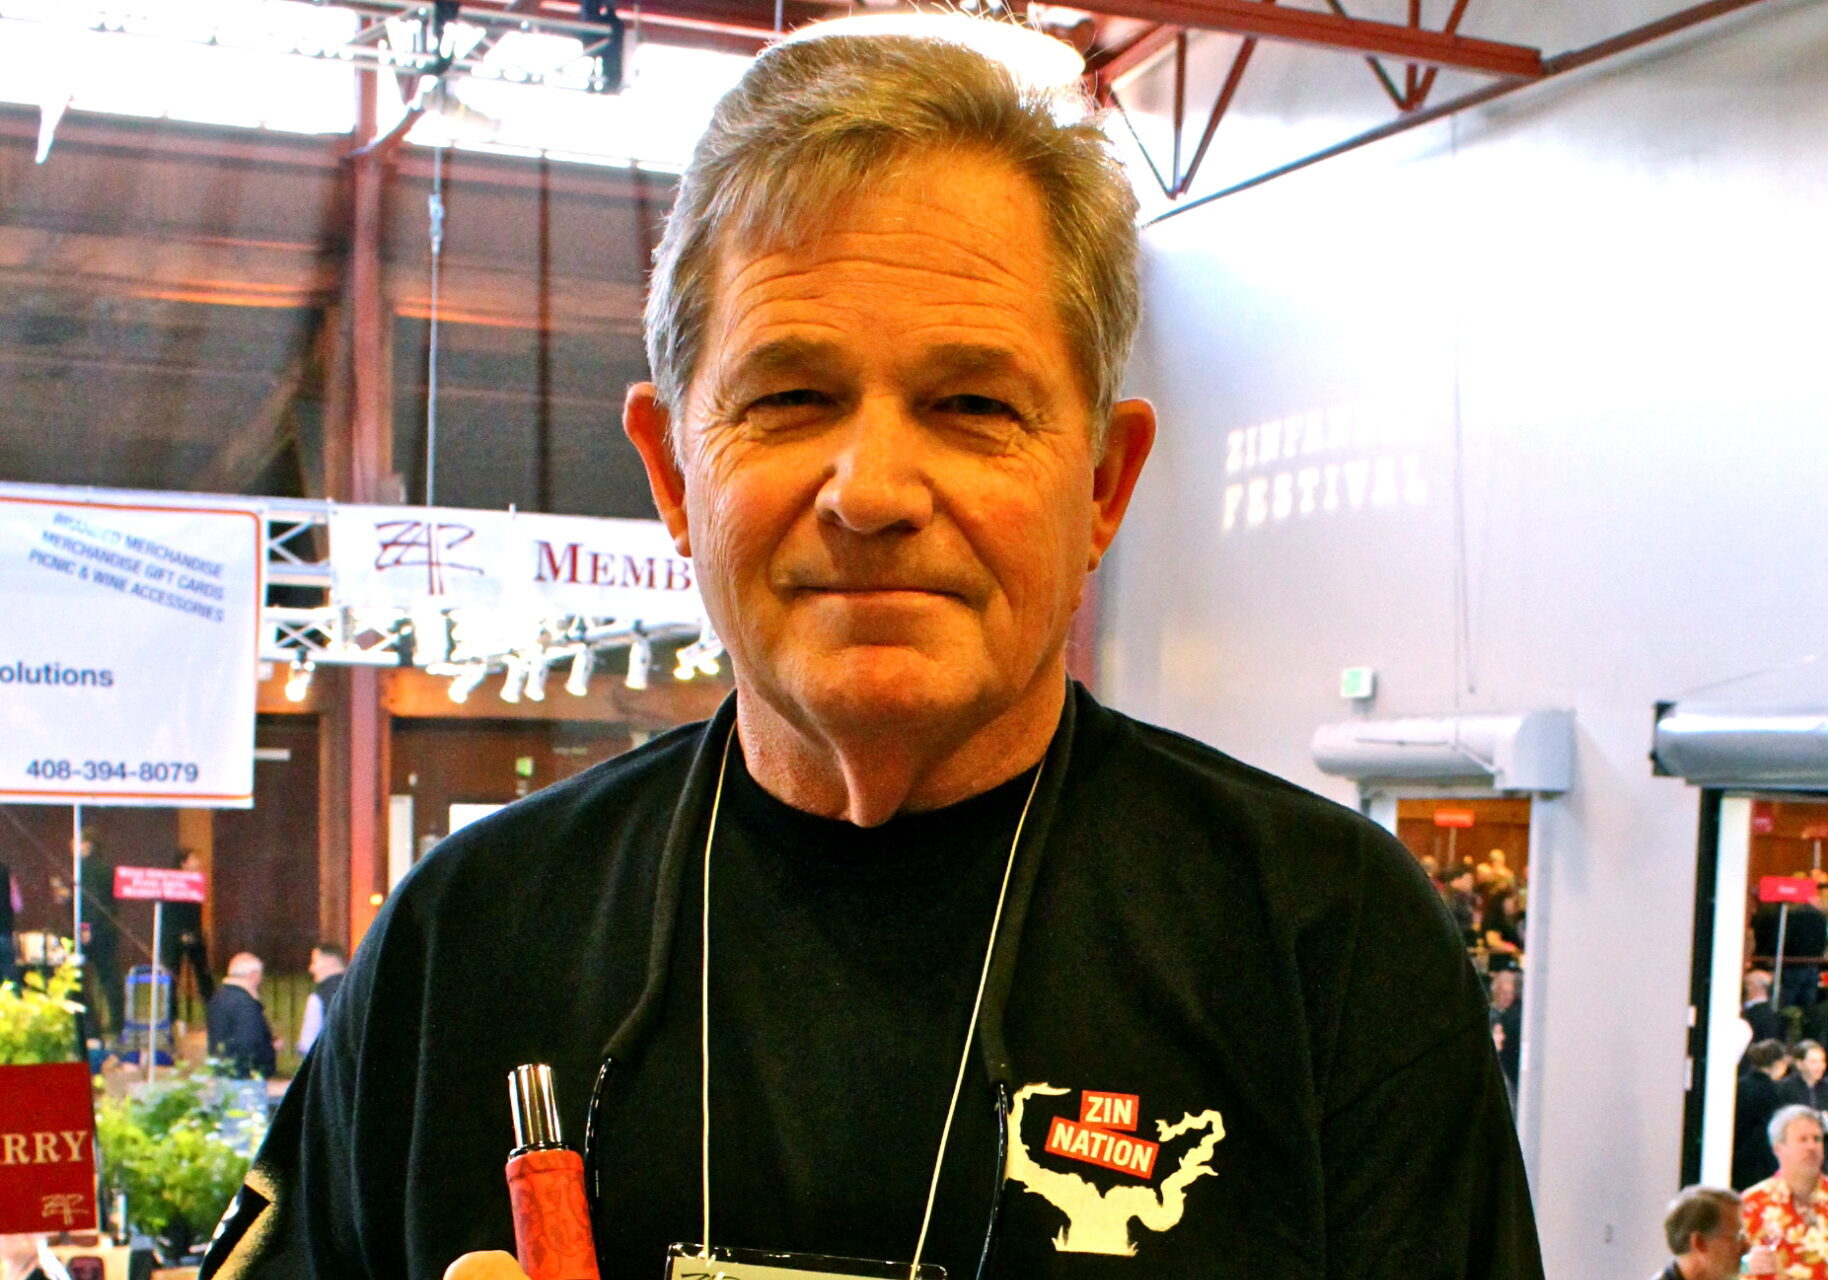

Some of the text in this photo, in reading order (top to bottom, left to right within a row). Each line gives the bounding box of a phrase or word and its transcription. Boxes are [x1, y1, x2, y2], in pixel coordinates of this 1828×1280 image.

[1221, 453, 1429, 531] FESTIVAL
[42, 529, 225, 601] MERCHANDISE GIFT CARDS
[125, 534, 224, 579] MERCHANDISE
[533, 539, 692, 592] MEMB
[28, 549, 225, 623] PICNIC & WINE ACCESSORIES
[26, 759, 199, 782] 408-394-8079
[1085, 1096, 1132, 1125] ZIN
[0, 1130, 88, 1165] RRY
[1051, 1122, 1153, 1172] NATION
